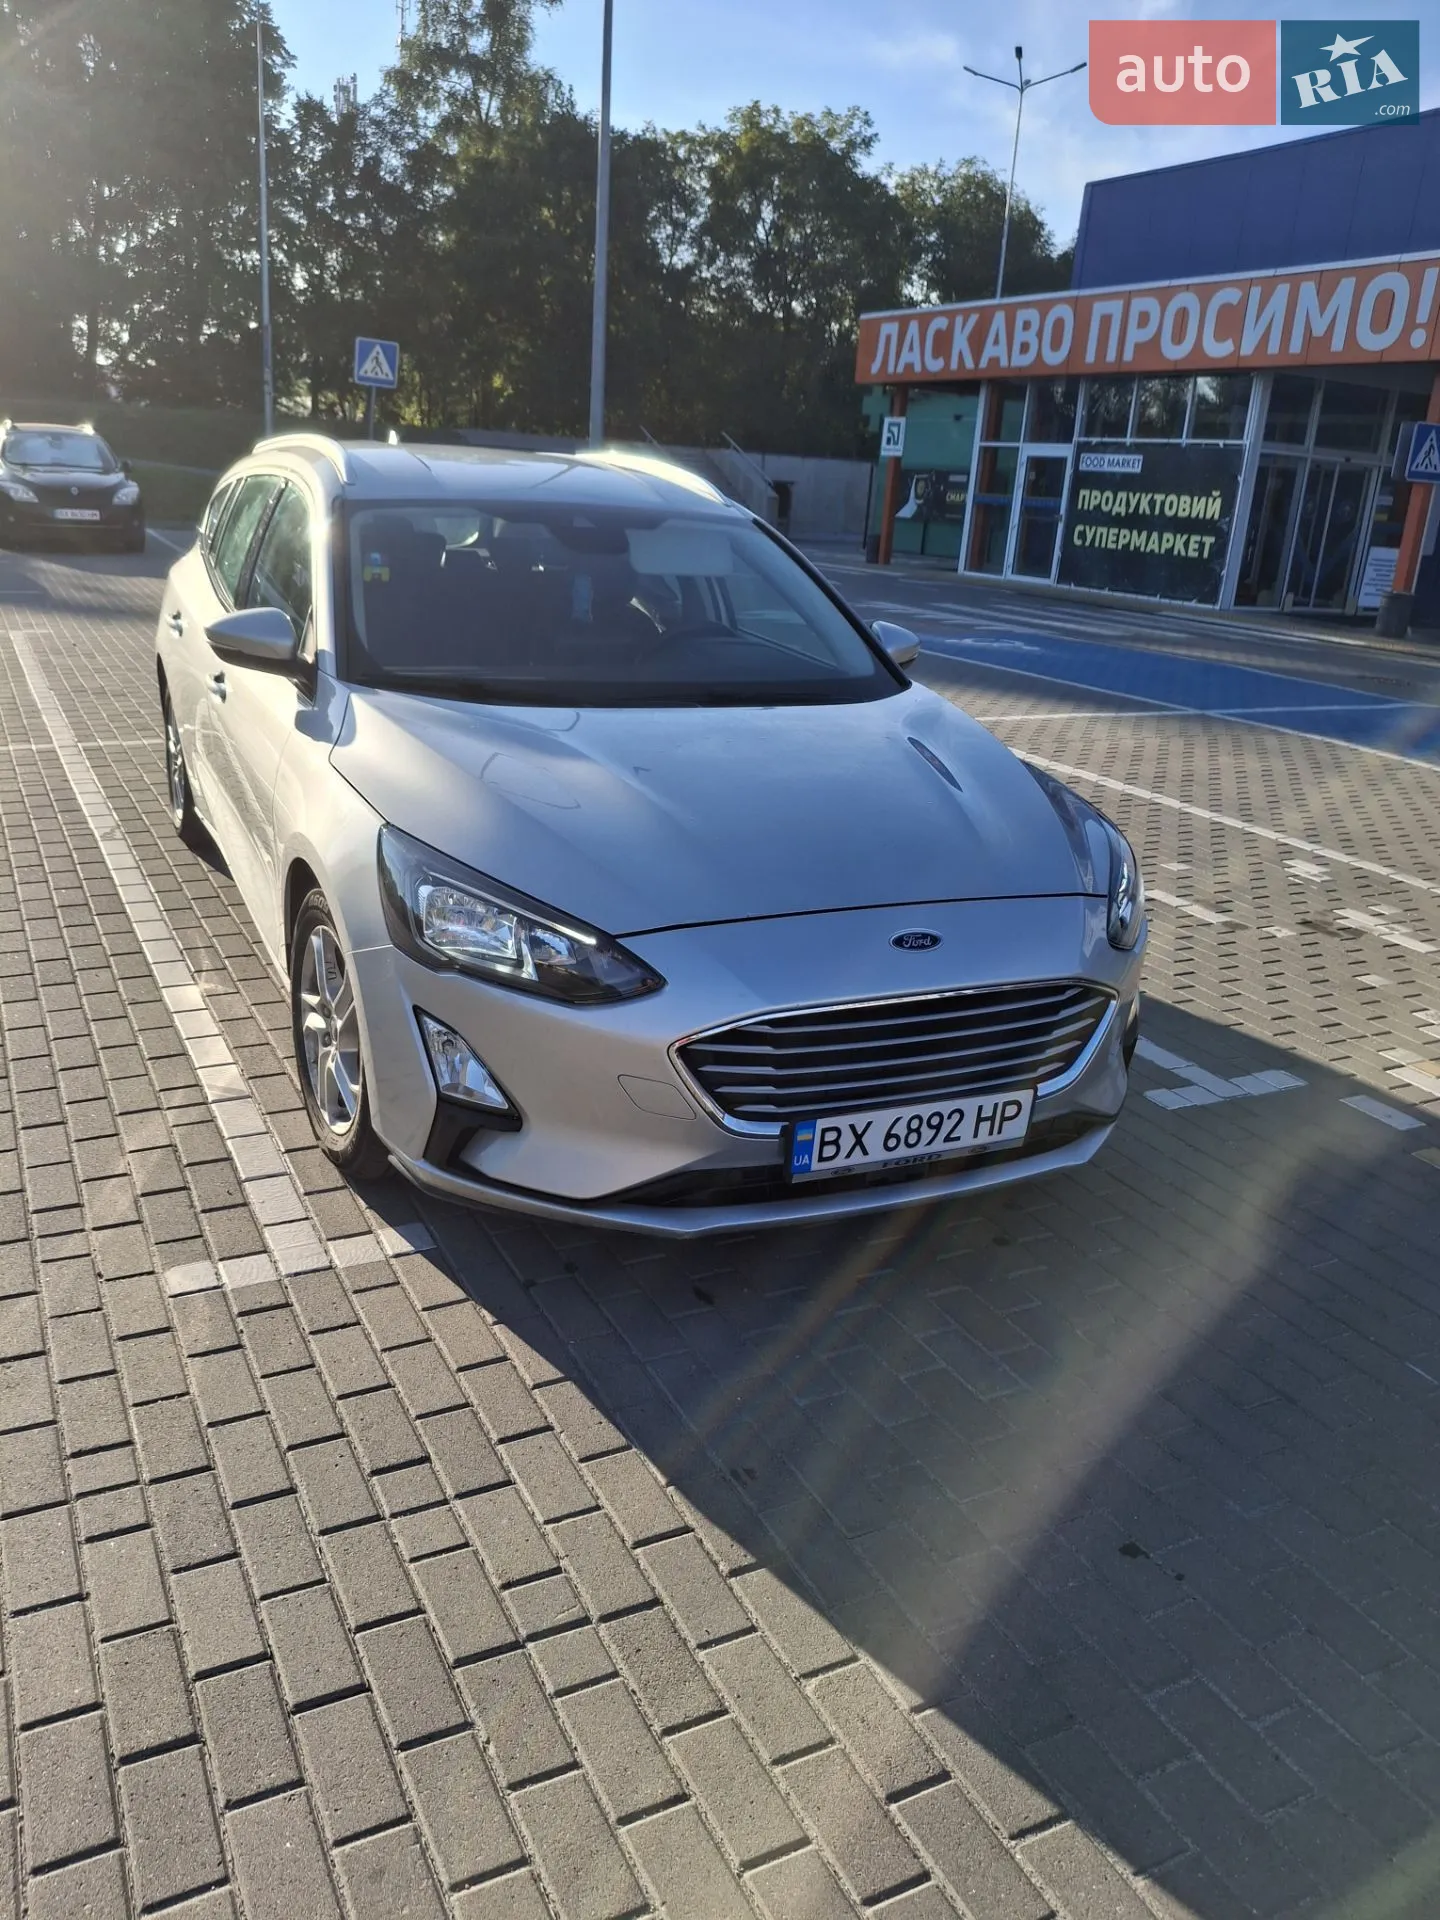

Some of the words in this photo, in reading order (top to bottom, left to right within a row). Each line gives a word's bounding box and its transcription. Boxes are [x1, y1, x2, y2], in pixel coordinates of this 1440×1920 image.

[870, 303, 1076, 375] ЛАСКАВО
[1084, 267, 1440, 364] ПРОСИМО!
[1081, 455, 1106, 468] FOOD
[1106, 457, 1142, 469] MARKET
[1077, 489, 1223, 520] ПРОДУКТОВИЙ
[1073, 524, 1216, 559] СУПЕРМАРКЕТ
[902, 934, 933, 948] Ford
[817, 1120, 874, 1163] BX
[882, 1108, 965, 1152] 6892
[972, 1099, 1023, 1139] HP
[793, 1154, 810, 1166] UA
[881, 1152, 944, 1169] FORD
